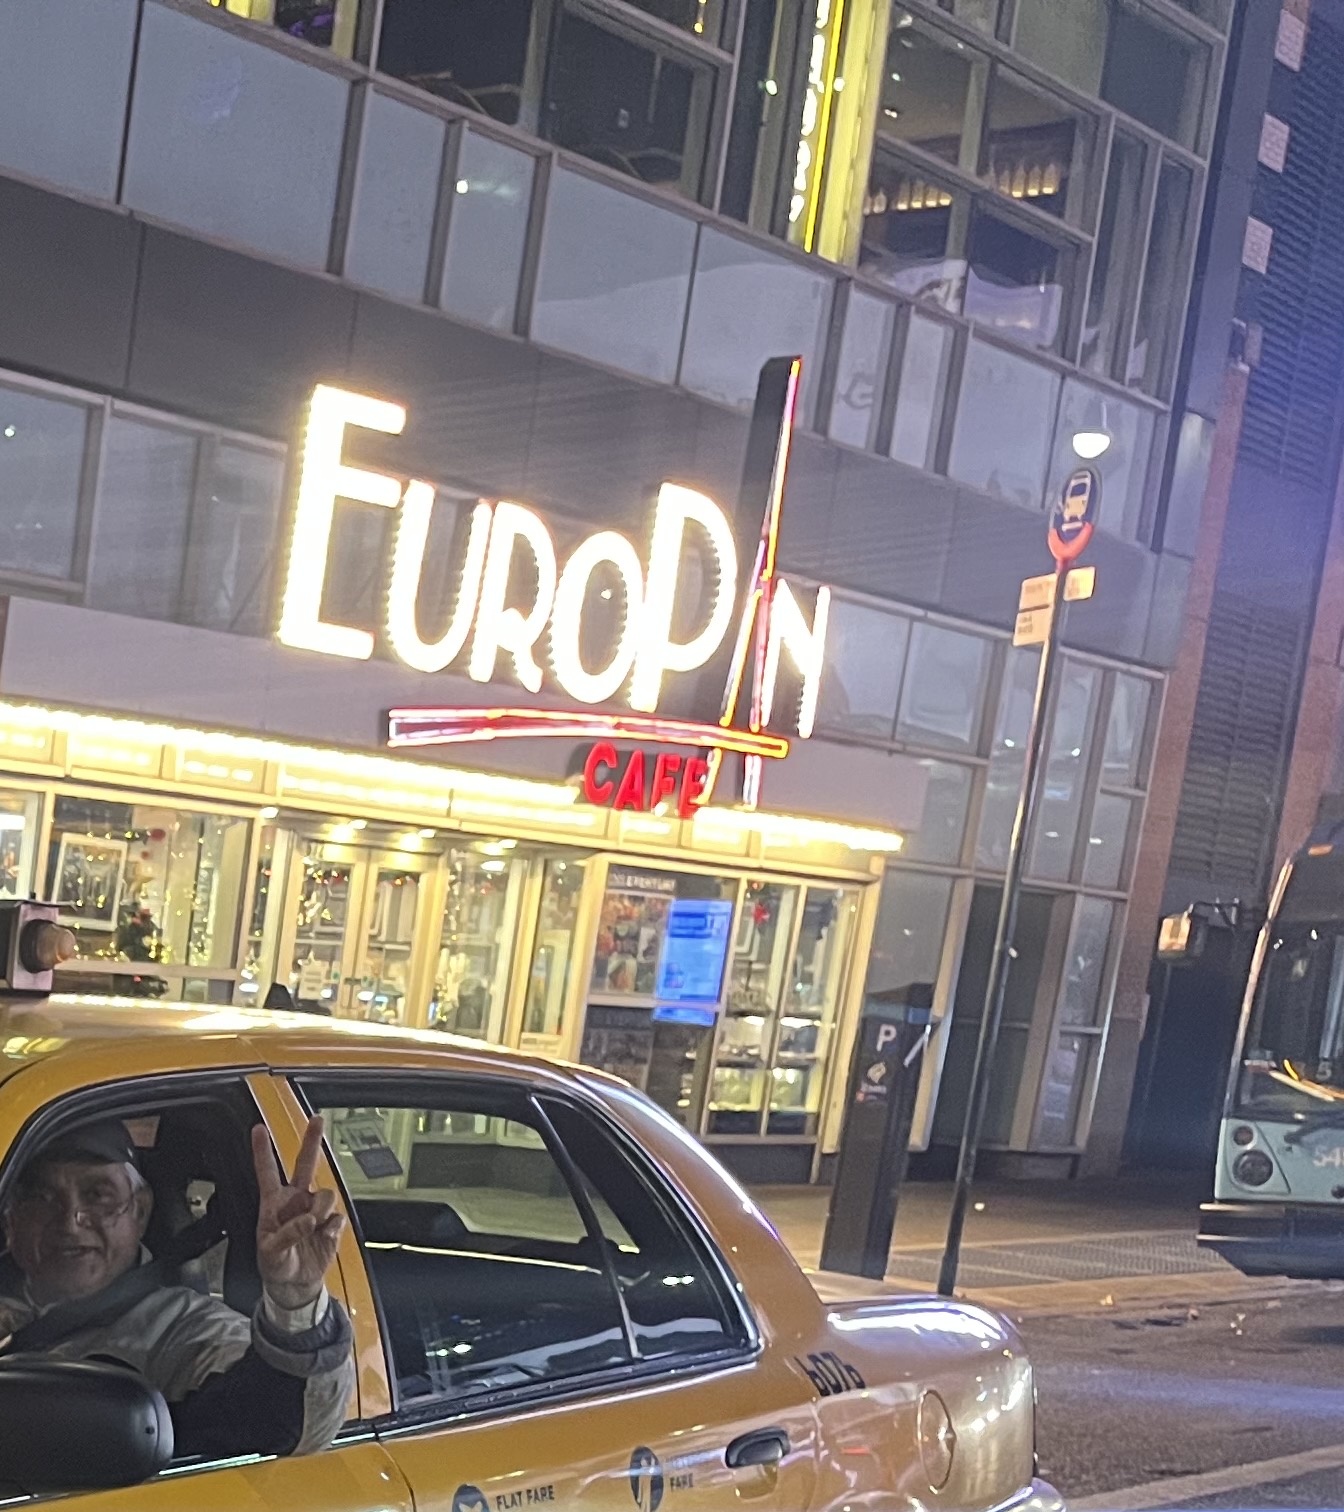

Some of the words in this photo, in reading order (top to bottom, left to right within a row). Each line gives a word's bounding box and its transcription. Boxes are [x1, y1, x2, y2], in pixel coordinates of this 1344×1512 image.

[583, 741, 712, 818] CAFE
[876, 1023, 897, 1052] P
[669, 1472, 694, 1493] FARE
[495, 1489, 524, 1512] FLAT
[526, 1484, 555, 1505] FARE
